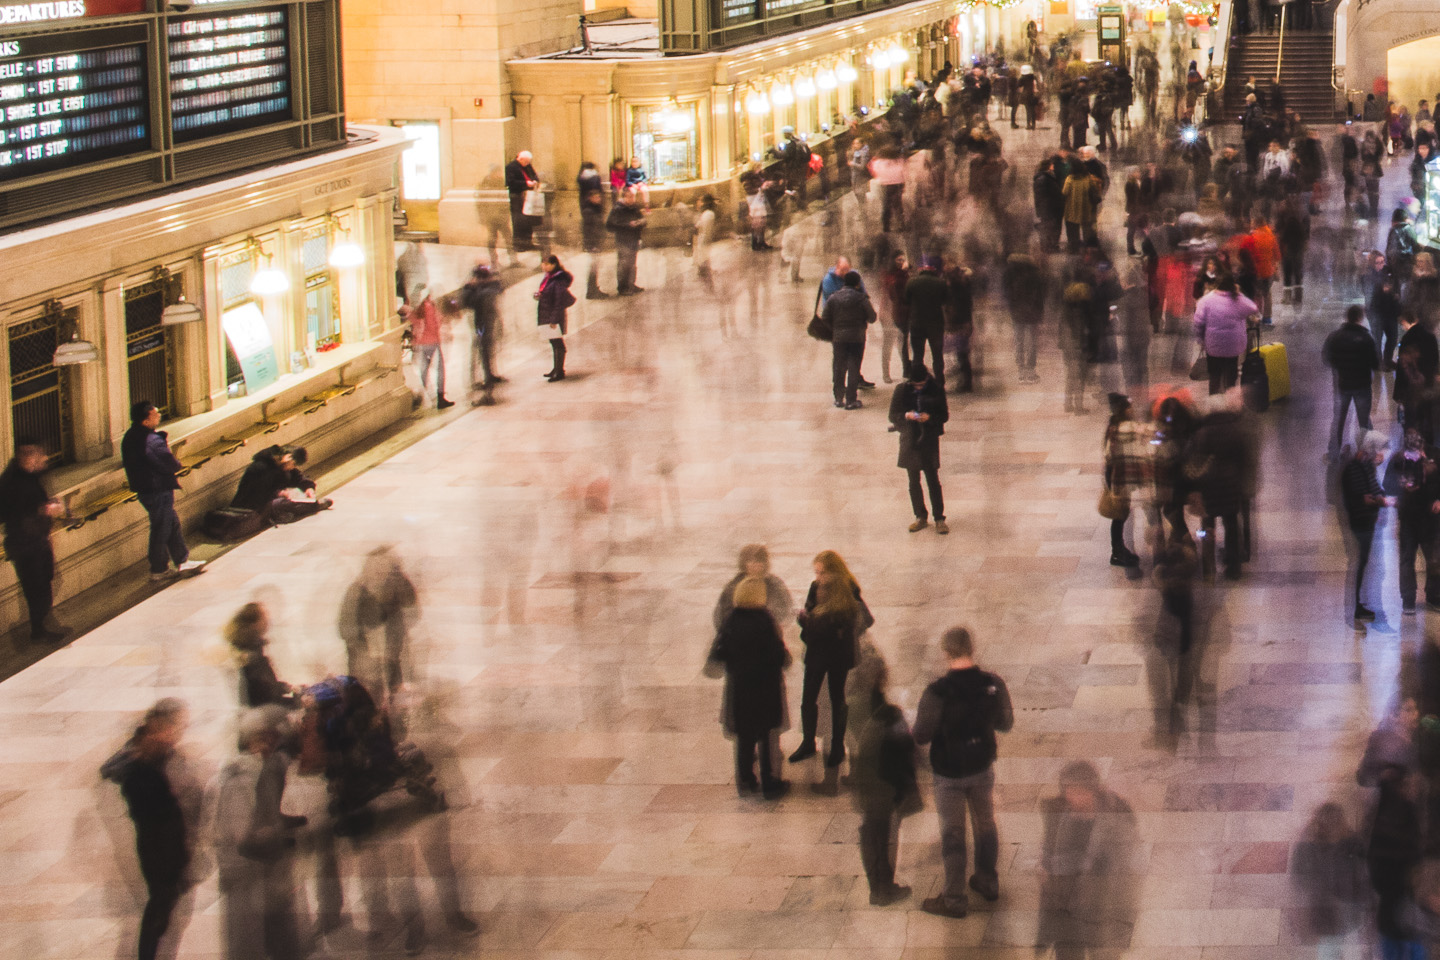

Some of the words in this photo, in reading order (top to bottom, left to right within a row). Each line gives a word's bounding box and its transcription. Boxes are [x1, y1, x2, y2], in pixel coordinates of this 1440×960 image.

[56, 53, 80, 71] STOP
[57, 75, 81, 91] STOP
[39, 119, 63, 137] STOP
[45, 139, 69, 157] STOP
